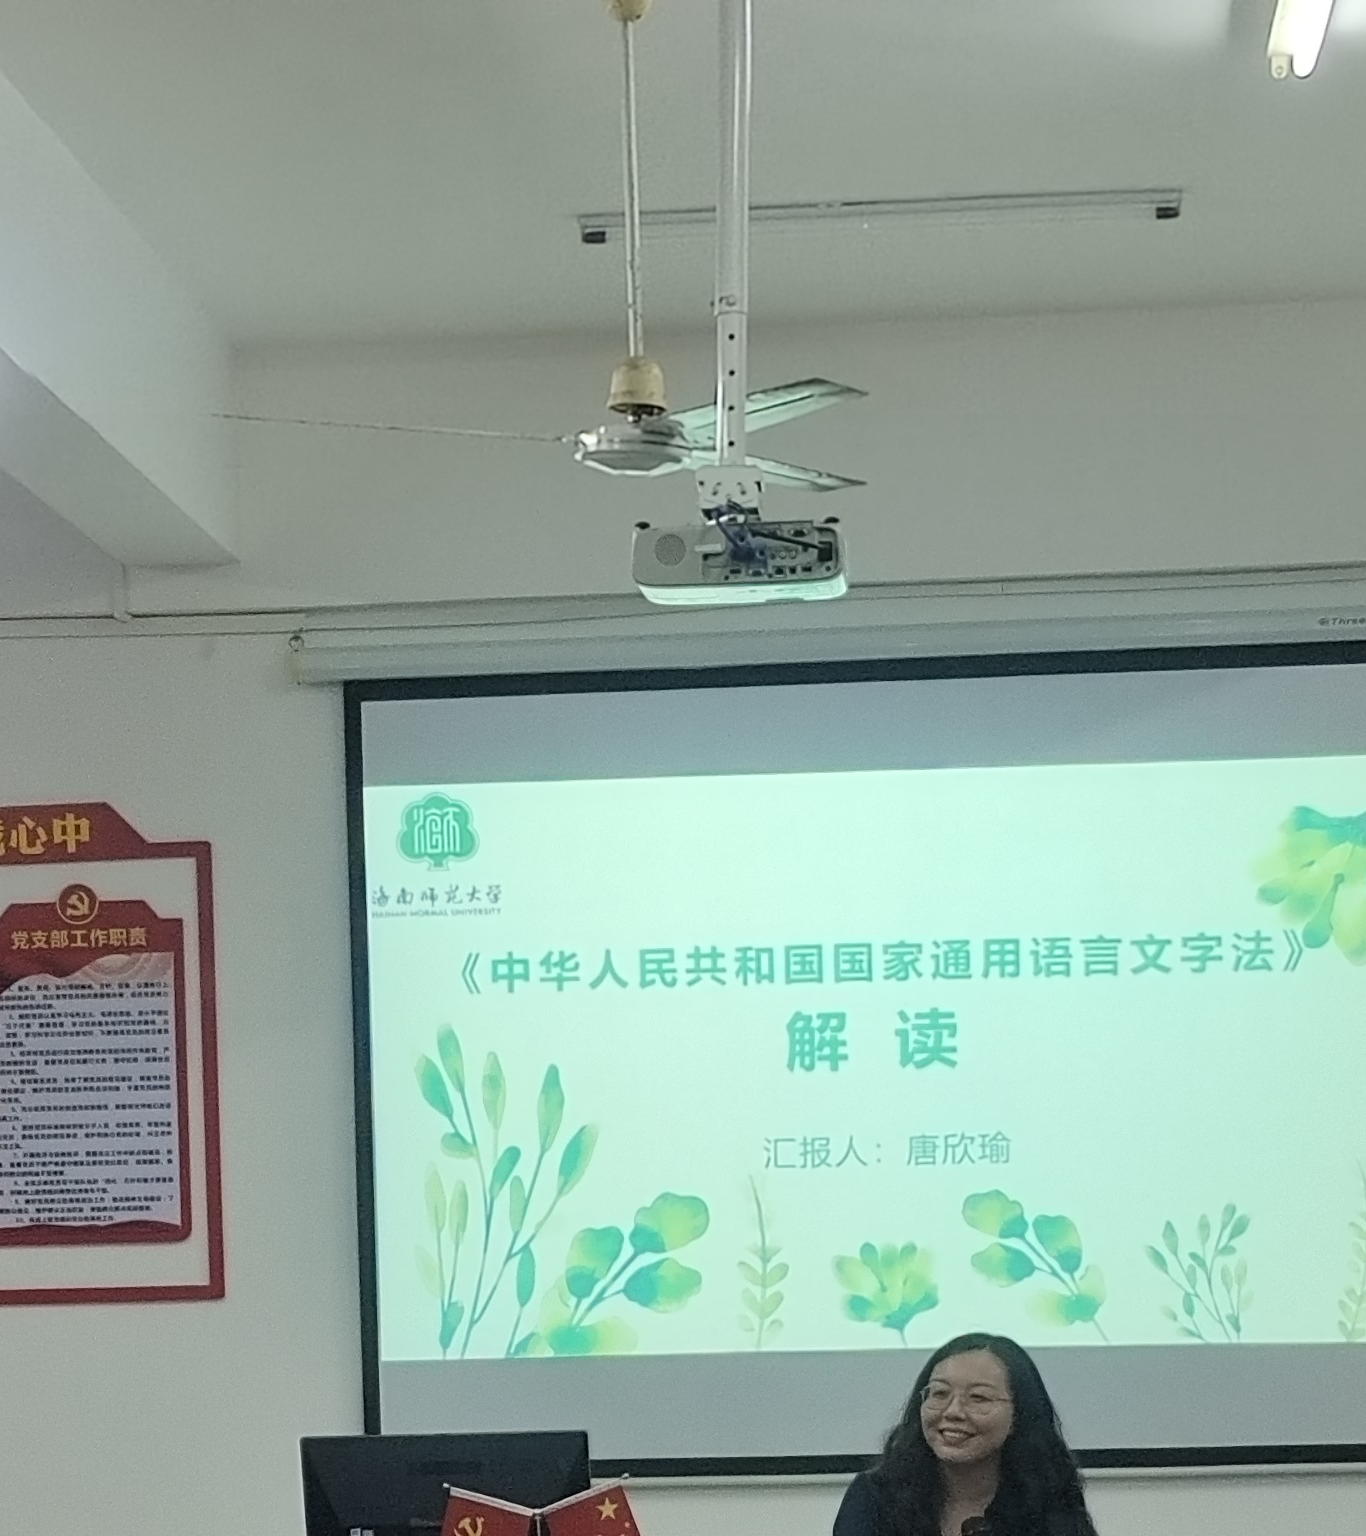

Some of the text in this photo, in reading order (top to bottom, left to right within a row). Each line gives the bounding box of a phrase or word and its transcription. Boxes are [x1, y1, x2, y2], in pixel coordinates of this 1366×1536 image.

[10, 927, 148, 951] 党支部工作职责
[460, 928, 1305, 996] 《中华人民共和国国家通用语言文字法》
